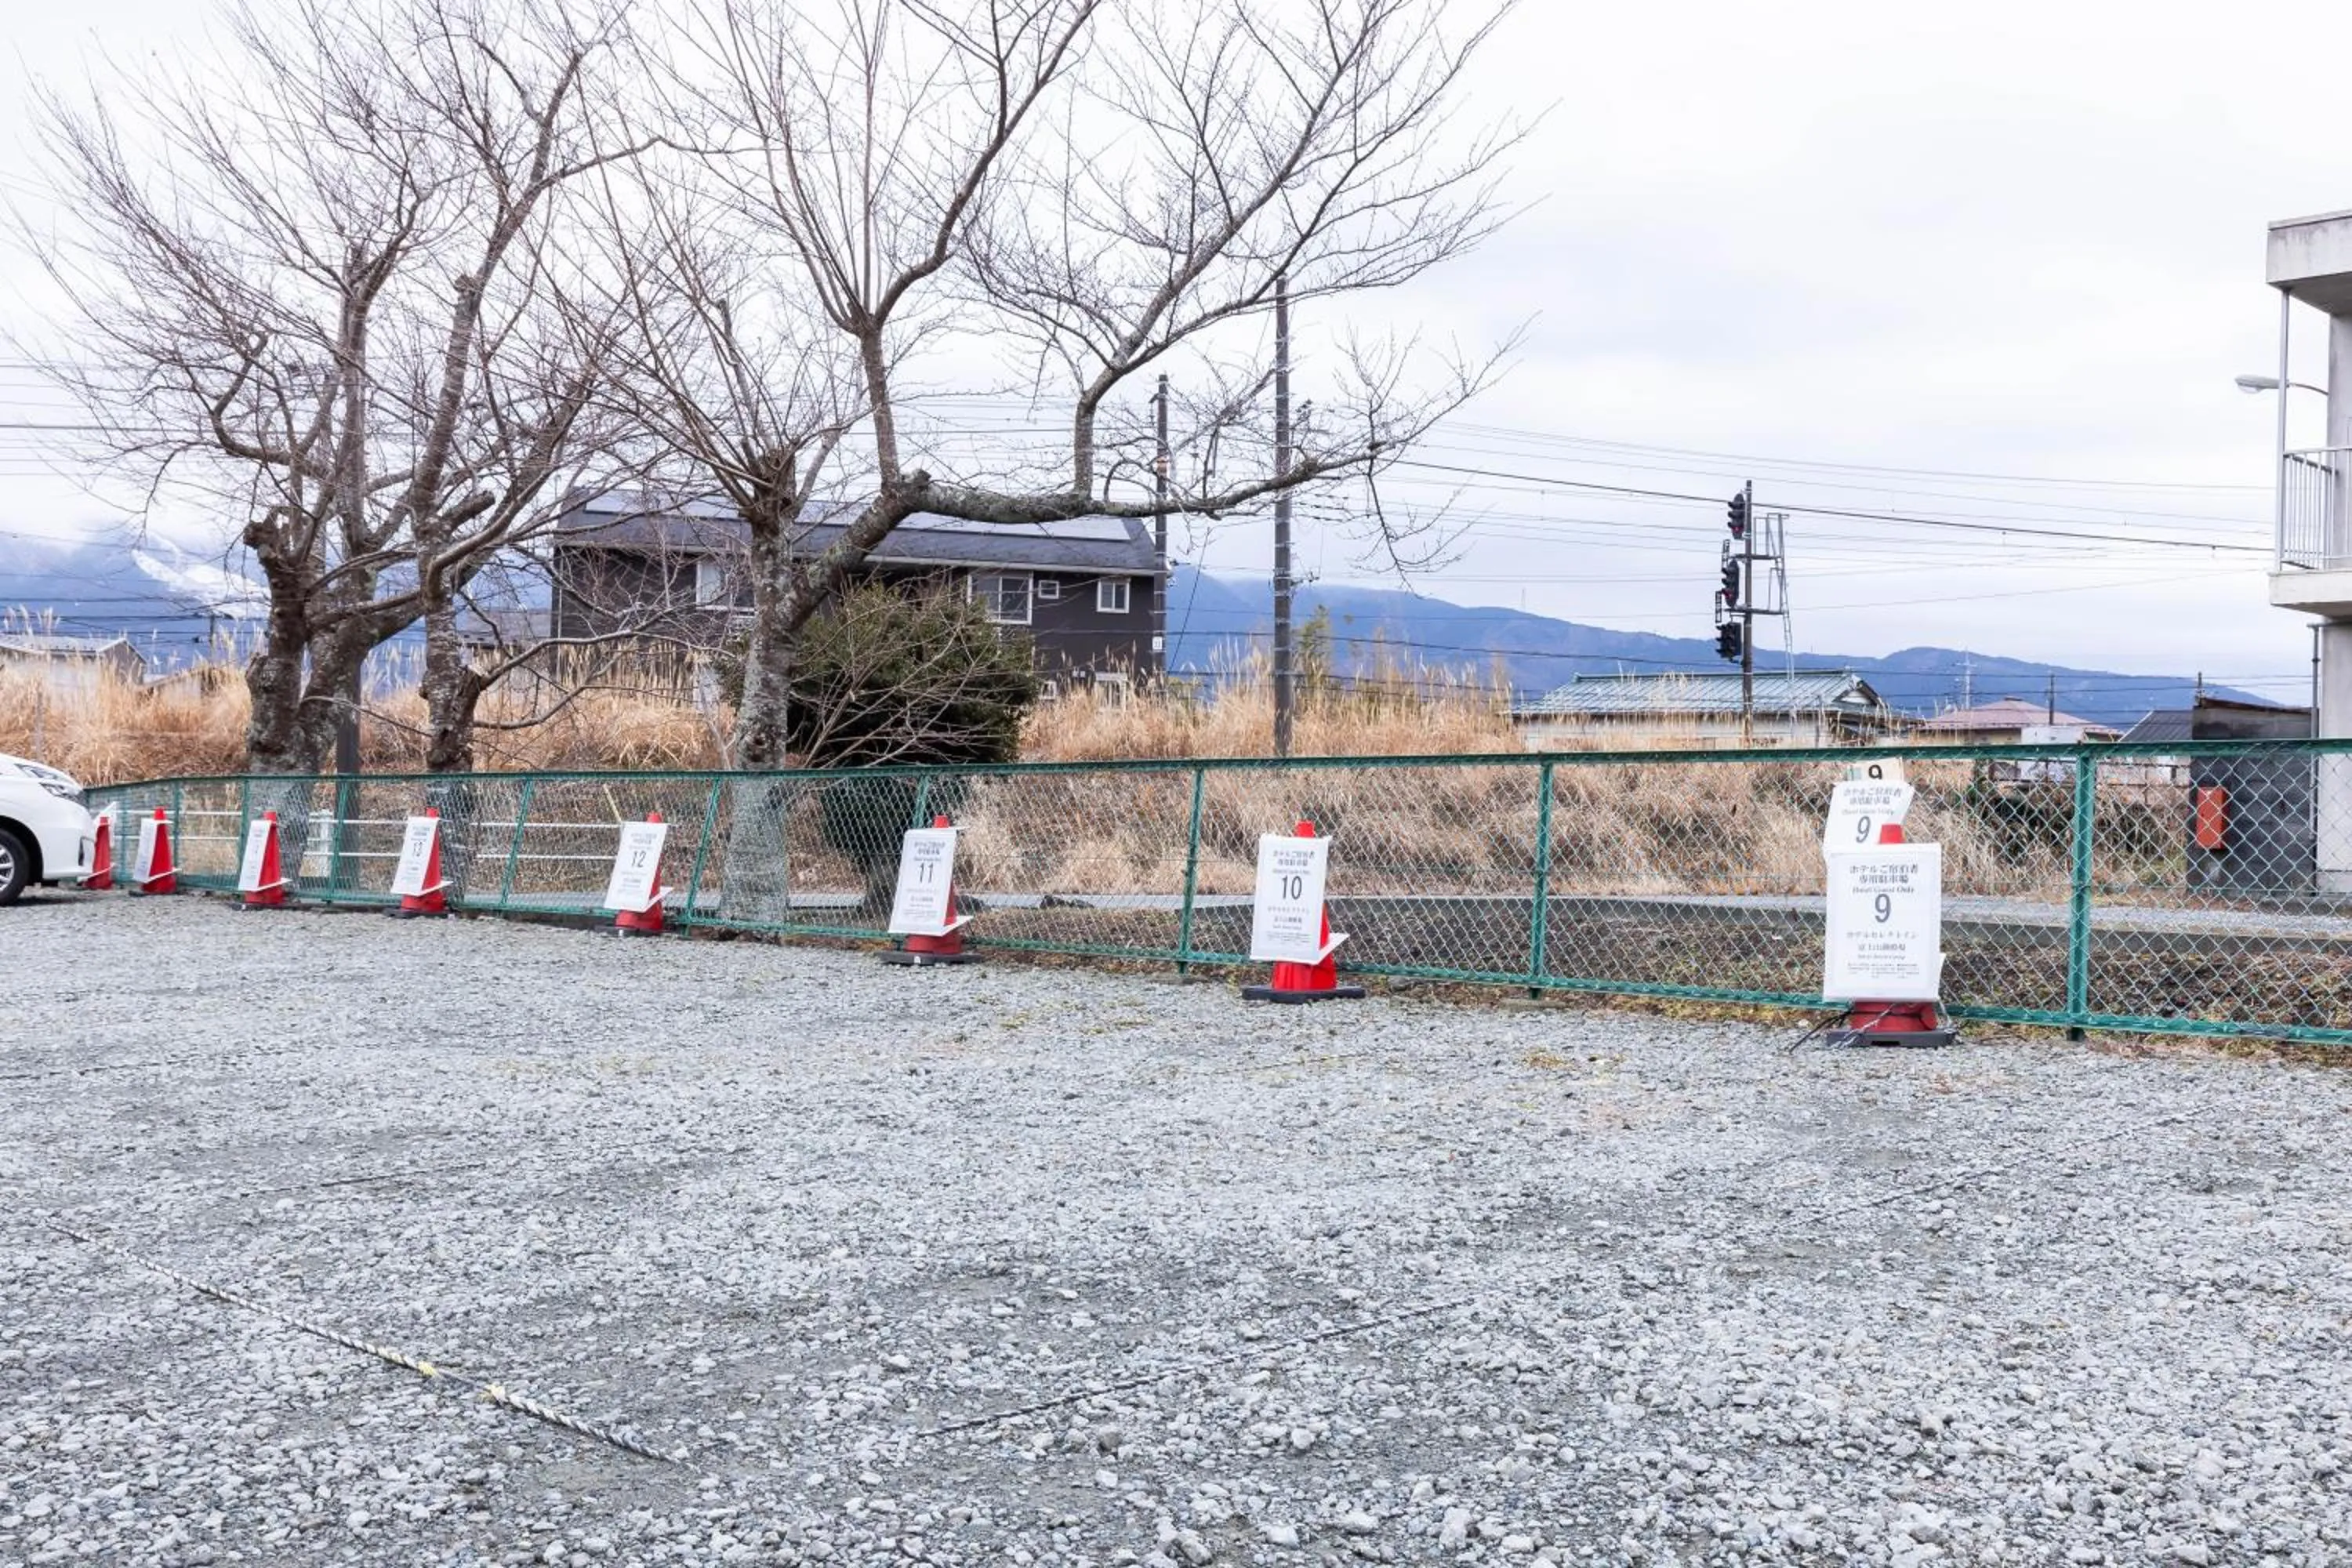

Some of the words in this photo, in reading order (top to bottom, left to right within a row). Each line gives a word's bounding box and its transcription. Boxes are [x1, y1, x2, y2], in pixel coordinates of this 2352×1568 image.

[1856, 815, 1871, 843] 9
[631, 851, 647, 868] 12
[920, 862, 934, 884] 11
[1282, 874, 1302, 900] 10
[1875, 893, 1892, 924] 9
